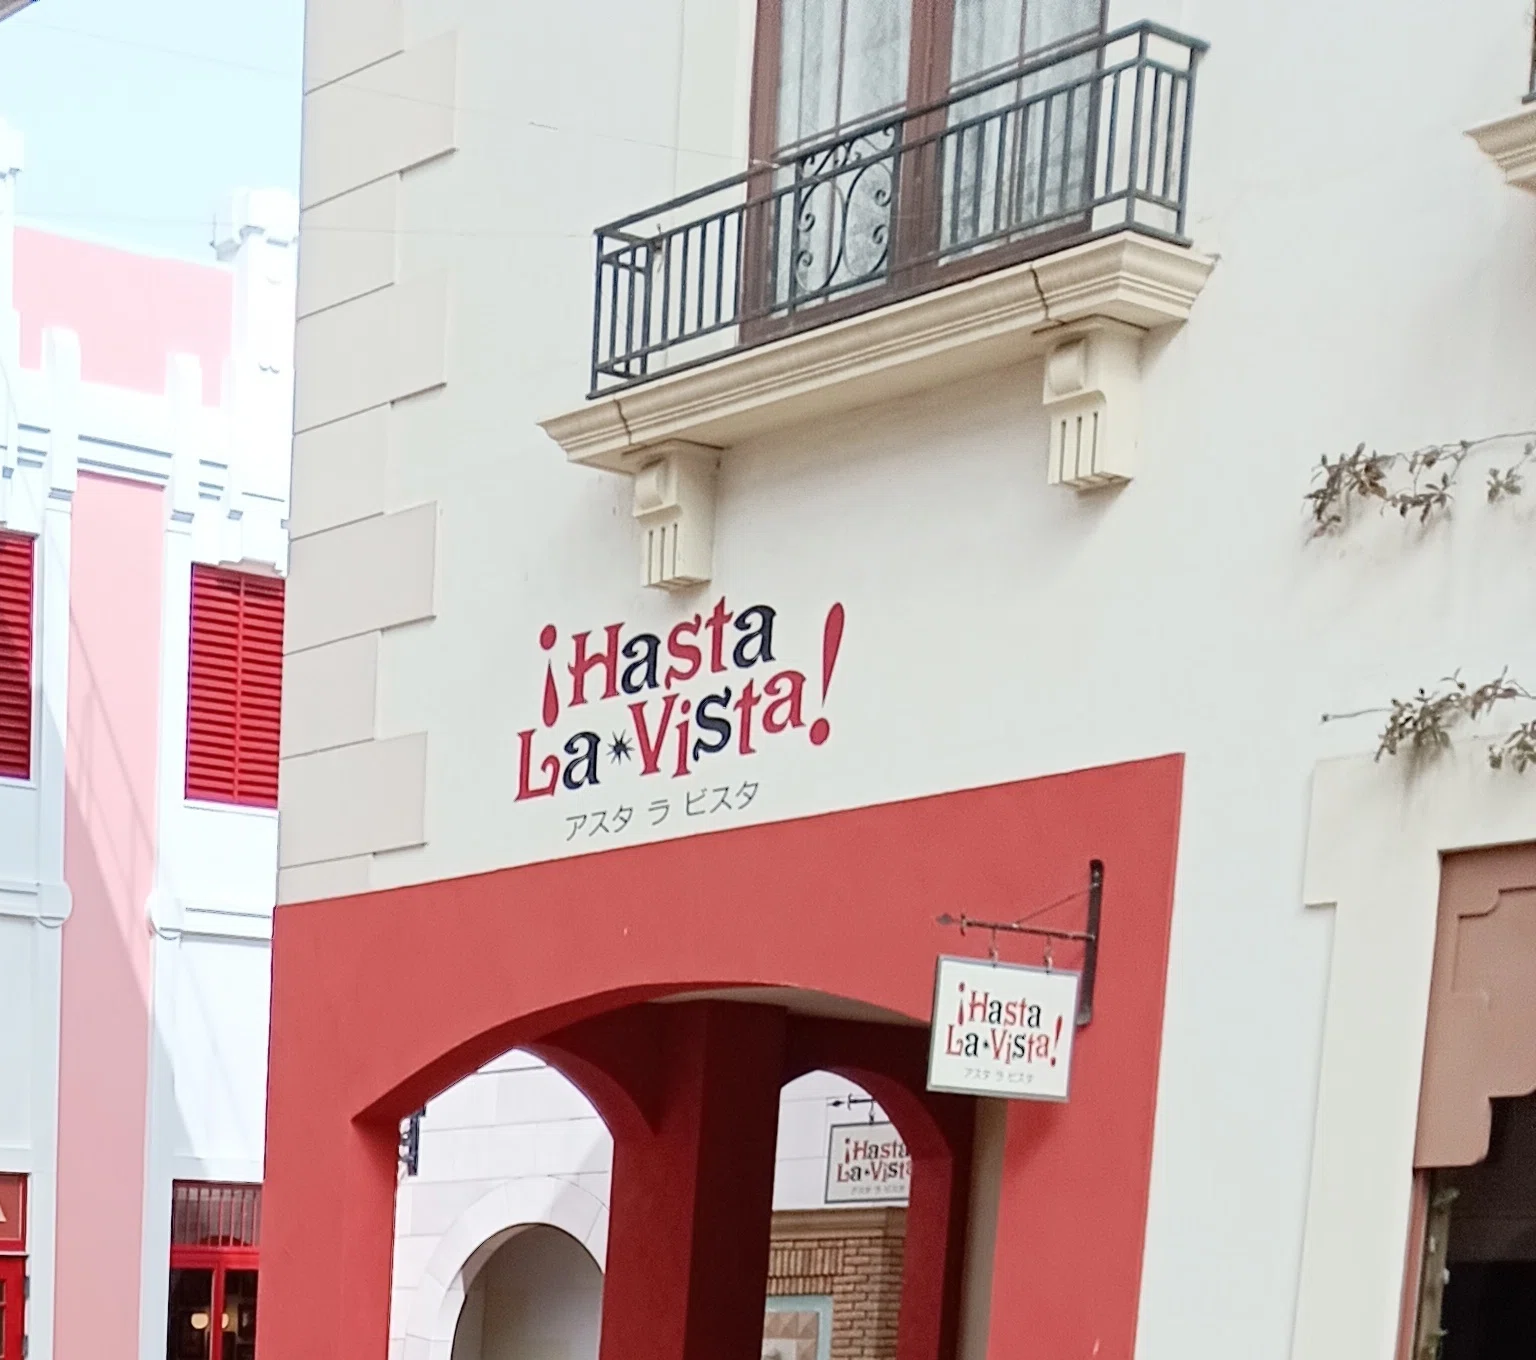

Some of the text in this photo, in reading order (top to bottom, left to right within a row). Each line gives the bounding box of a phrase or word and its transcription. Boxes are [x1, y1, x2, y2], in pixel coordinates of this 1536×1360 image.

[540, 597, 776, 727] ¡Hasta
[514, 601, 845, 801] La Vista!
[565, 781, 759, 841] アスタ ラ ビスタ
[958, 981, 1041, 1029] ¡Hasta
[945, 1015, 1063, 1068] La Vista!
